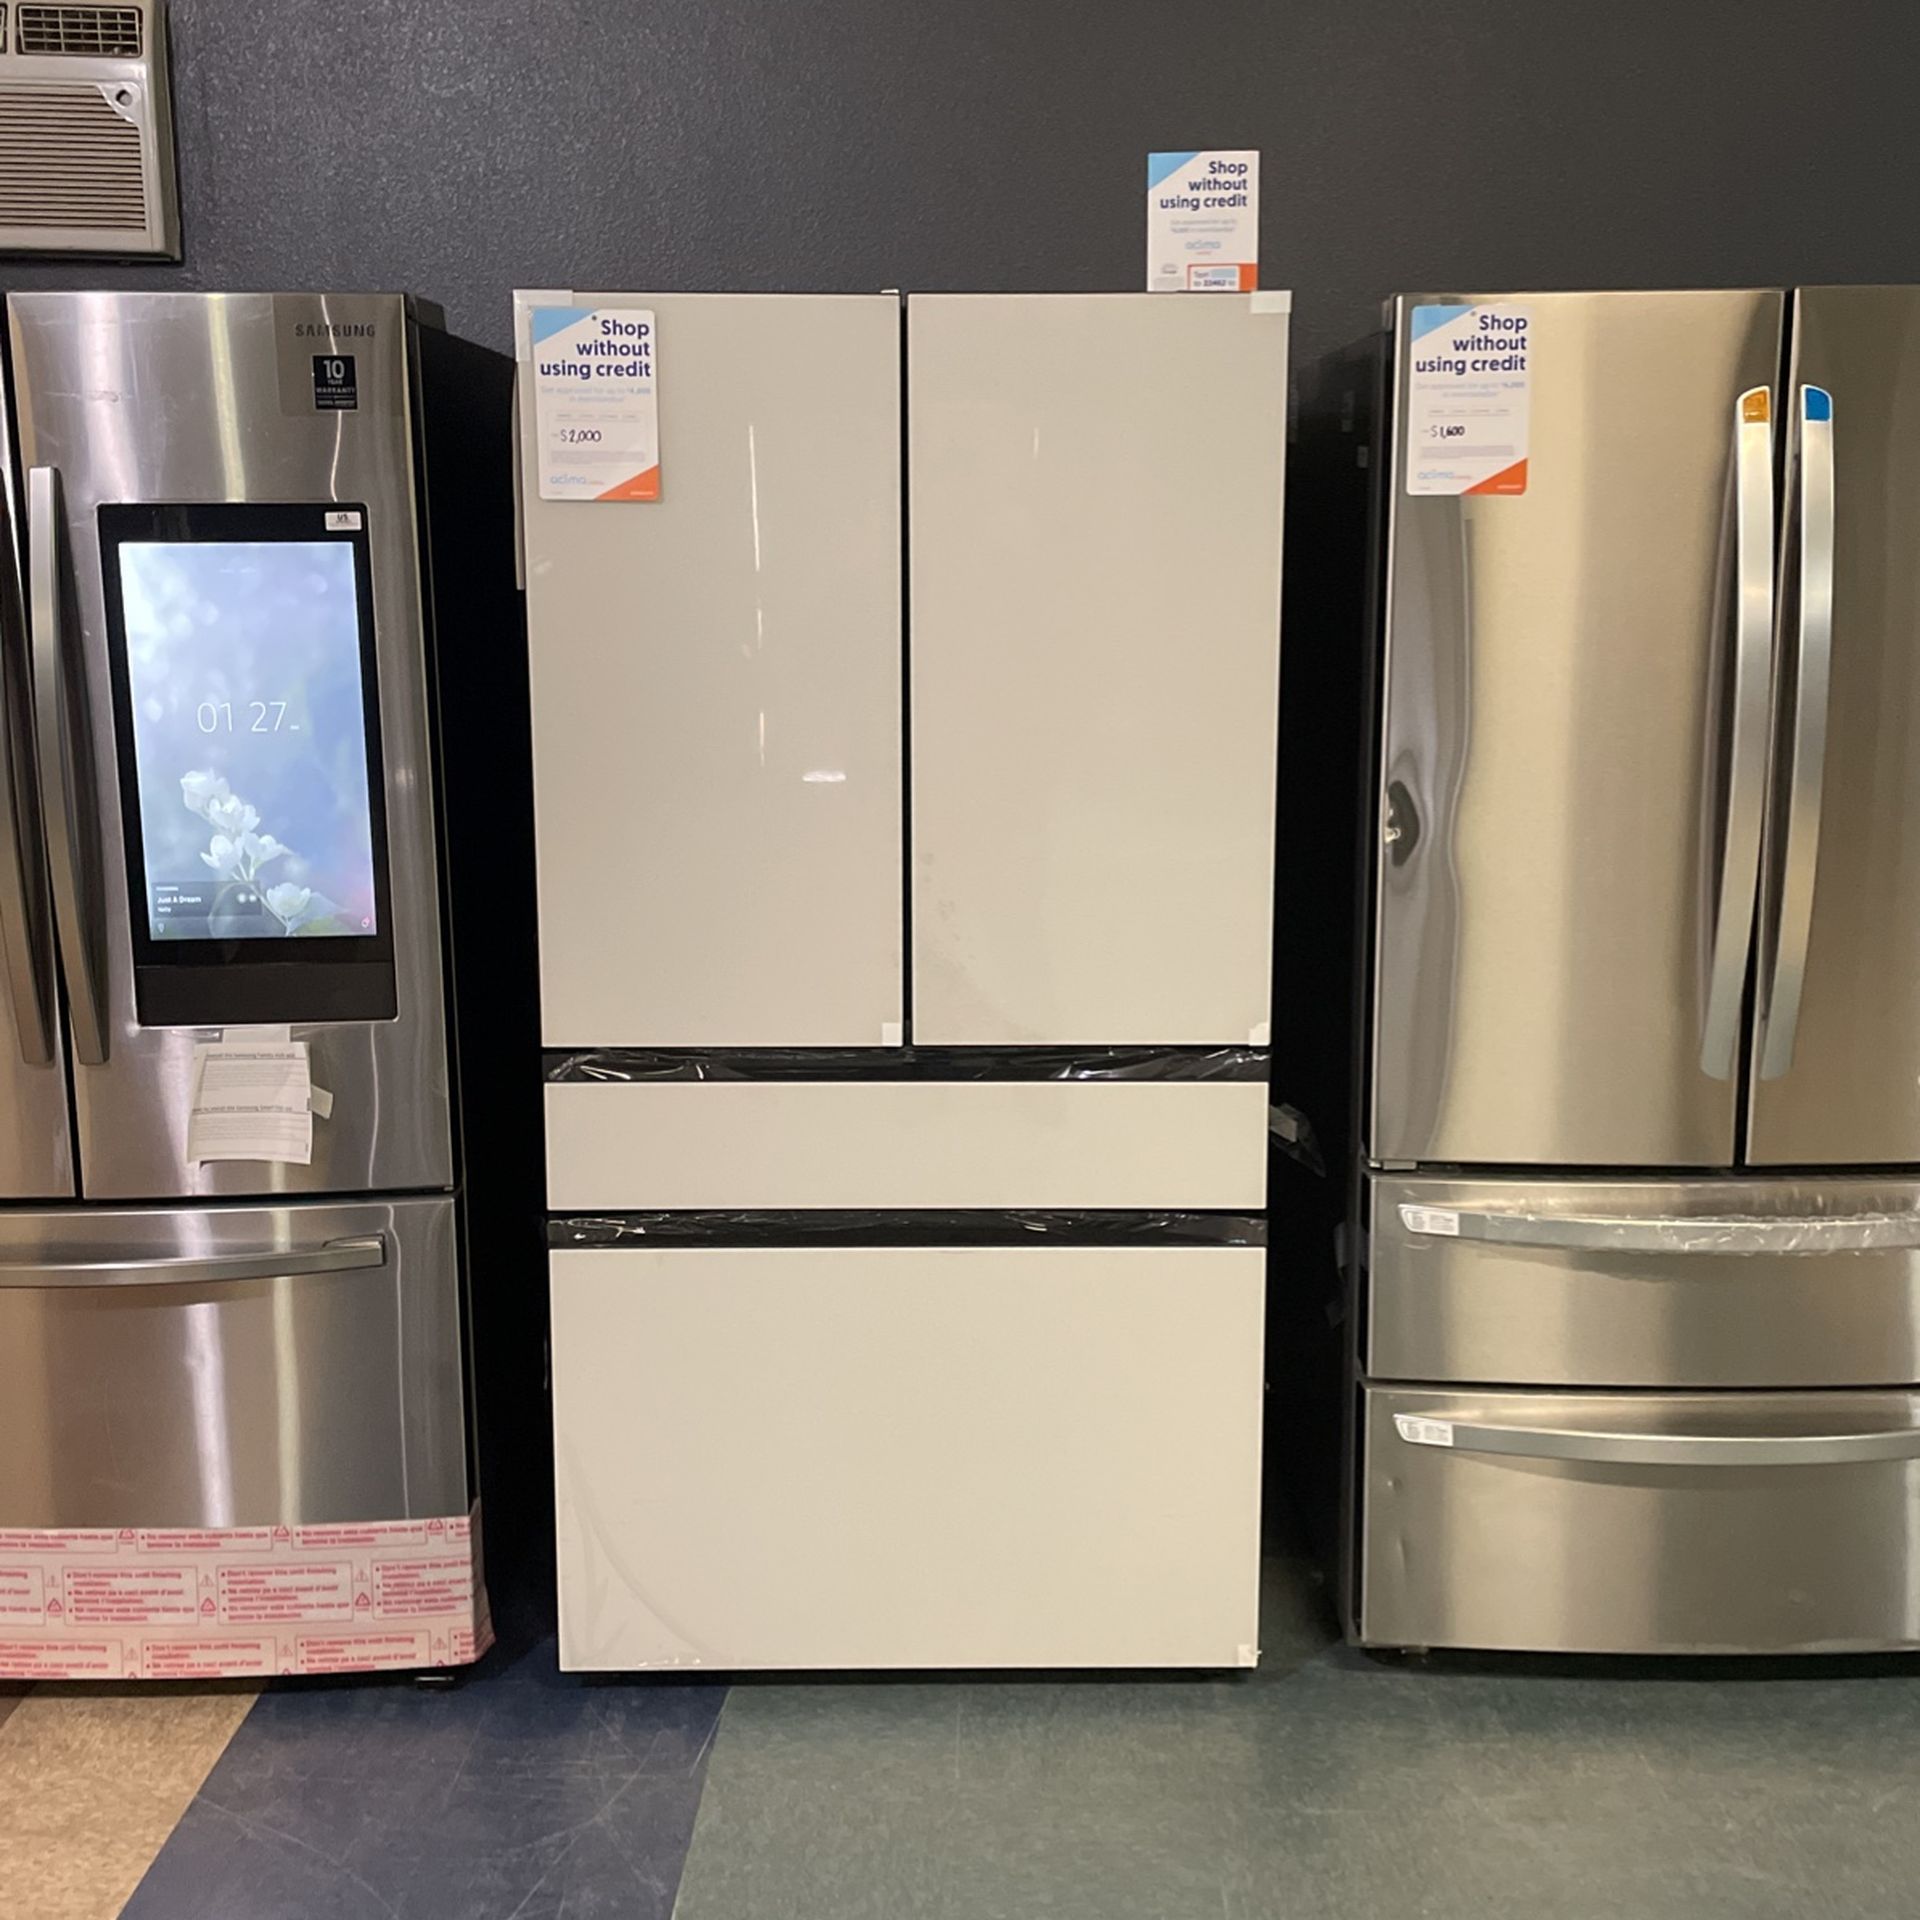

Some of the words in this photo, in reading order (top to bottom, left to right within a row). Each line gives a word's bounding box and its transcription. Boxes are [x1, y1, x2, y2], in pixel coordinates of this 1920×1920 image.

[1209, 161, 1248, 177] Shop
[1188, 178, 1248, 191] without
[1160, 195, 1200, 211] using
[1203, 194, 1247, 207] credit
[295, 324, 376, 337] SAMSUNG
[601, 319, 649, 339] Shop
[1479, 315, 1527, 333] Shop
[576, 340, 650, 356] without
[1453, 335, 1527, 351] without
[323, 360, 345, 379] 10
[540, 360, 591, 380] using
[596, 360, 651, 377] credit
[1416, 356, 1466, 376] using
[1471, 355, 1526, 372] credit
[197, 702, 232, 733] 01
[249, 701, 287, 732] 27
